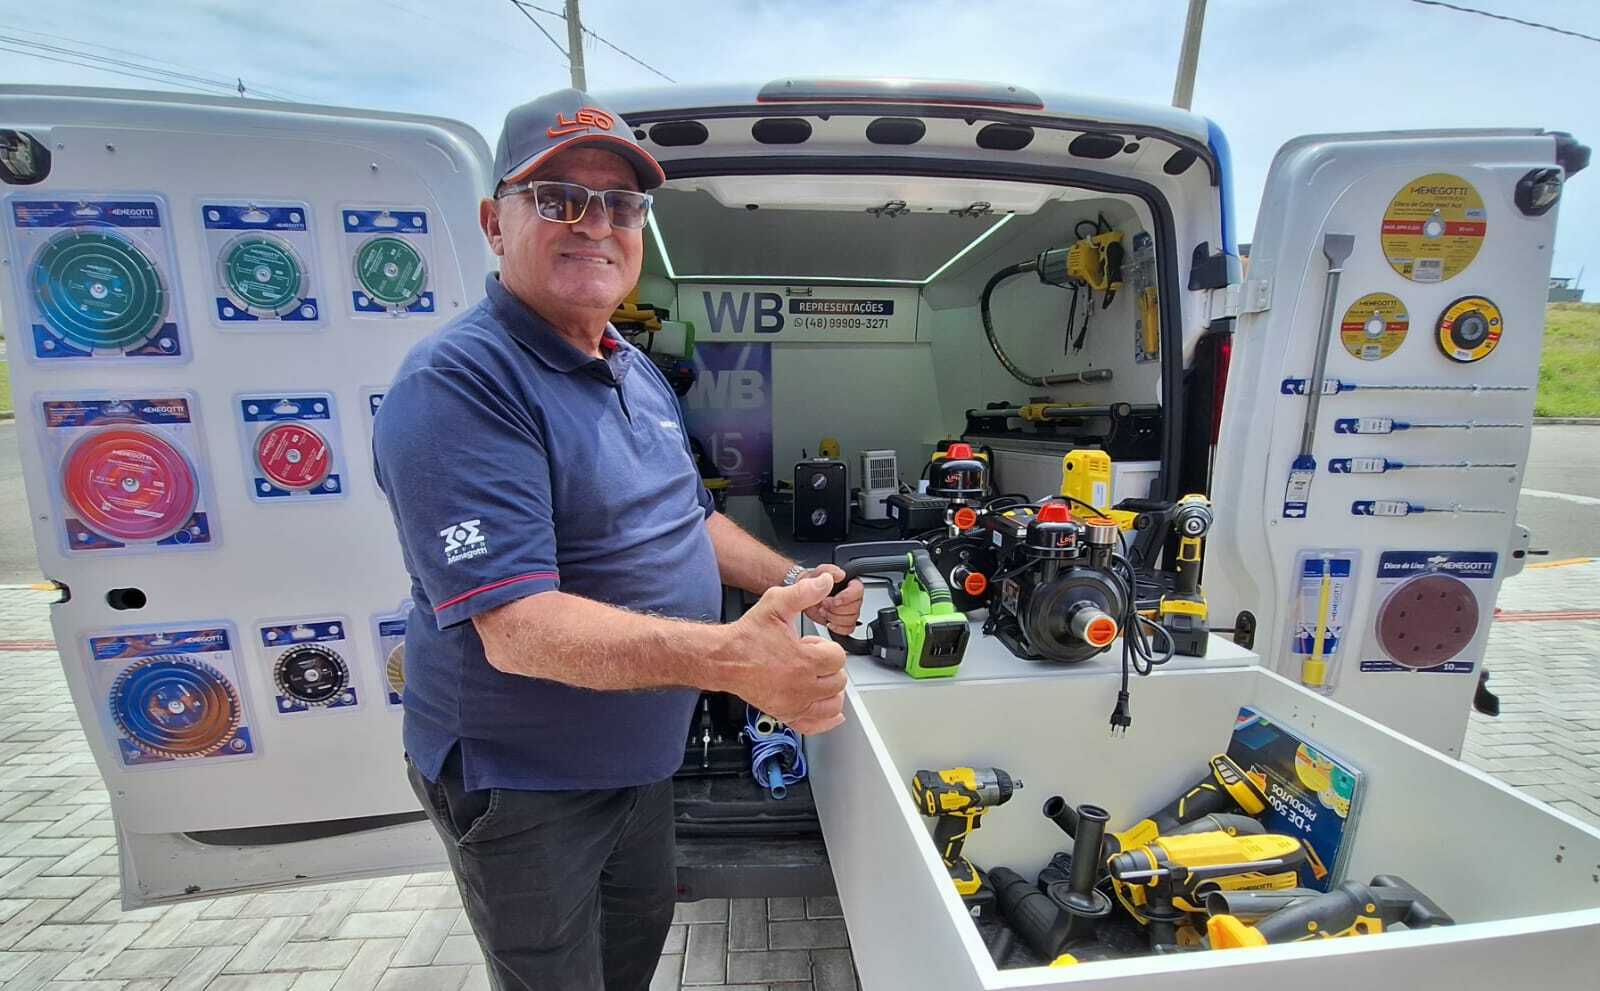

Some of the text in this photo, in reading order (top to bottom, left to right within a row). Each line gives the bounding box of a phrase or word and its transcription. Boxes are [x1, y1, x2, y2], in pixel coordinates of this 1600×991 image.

[547, 106, 614, 138] LEO
[1408, 184, 1468, 196] MENEGOTTI
[702, 291, 785, 334] WB
[799, 300, 884, 313] REPRESENTAÇÕES
[805, 317, 888, 330] (48) 99909-3271
[691, 369, 765, 409] WB
[709, 431, 744, 471] 15
[1444, 663, 1455, 671] 10
[1268, 795, 1288, 816] 500
[1271, 783, 1317, 822] PRODUTOS
[1287, 809, 1305, 829] DE
